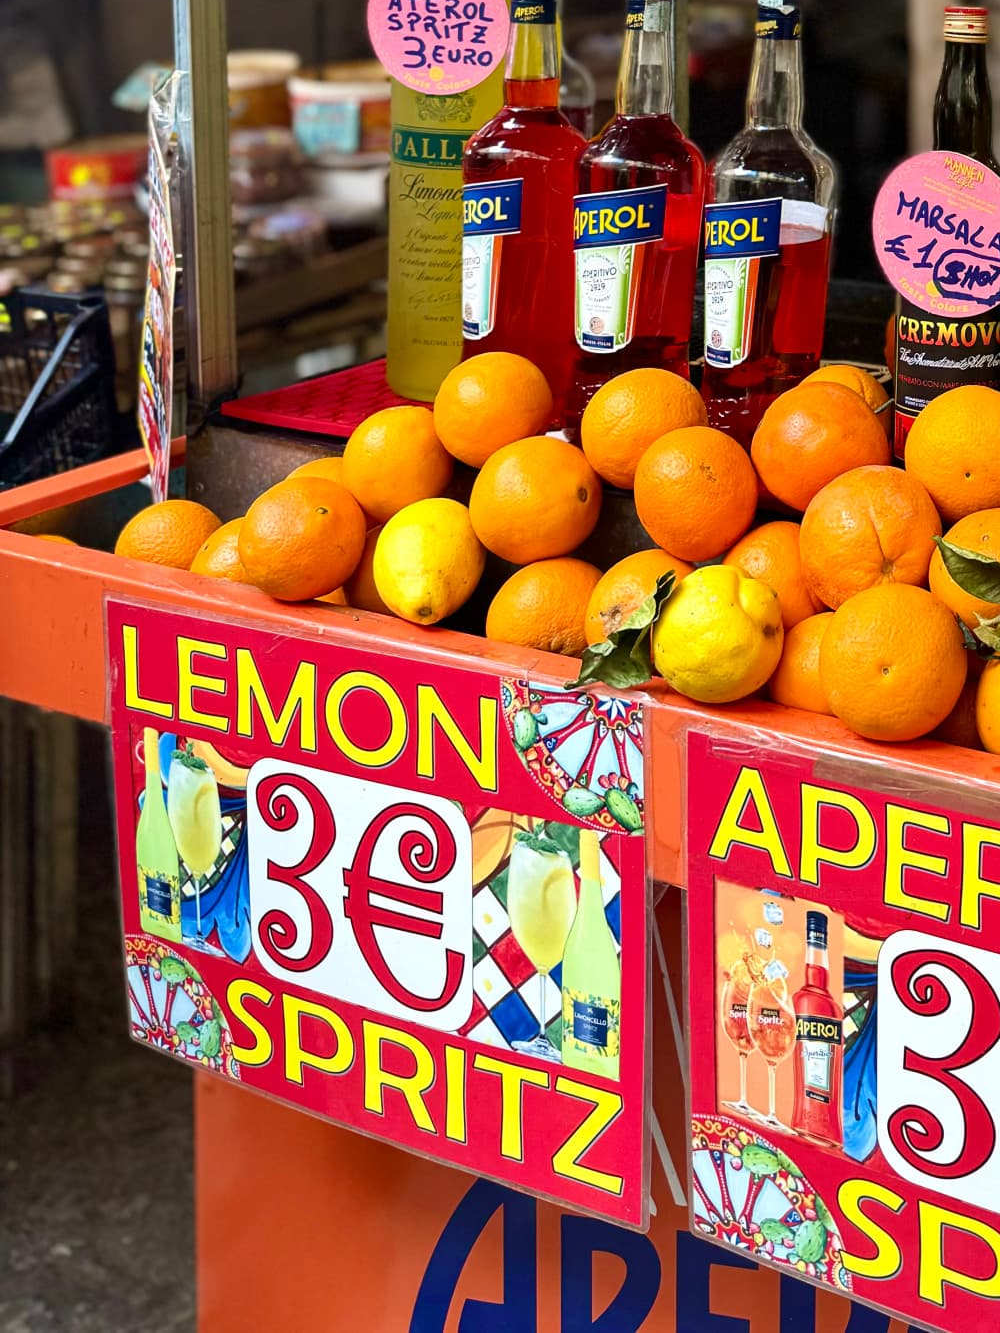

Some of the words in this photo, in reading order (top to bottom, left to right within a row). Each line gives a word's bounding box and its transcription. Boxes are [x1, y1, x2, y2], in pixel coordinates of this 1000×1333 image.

[514, 5, 545, 19] APEROL
[432, 45, 493, 67] EURO
[943, 156, 985, 184] MANNEN
[574, 204, 650, 240] APEROL
[582, 266, 617, 279] APERITIVO
[122, 624, 498, 794] LEMON
[255, 772, 466, 1012] 3€
[574, 1012, 607, 1026] LIMONCELLO
[758, 1016, 785, 1026] Spritz
[796, 1018, 839, 1040] APEROL
[226, 979, 624, 1197] SPRITZ
